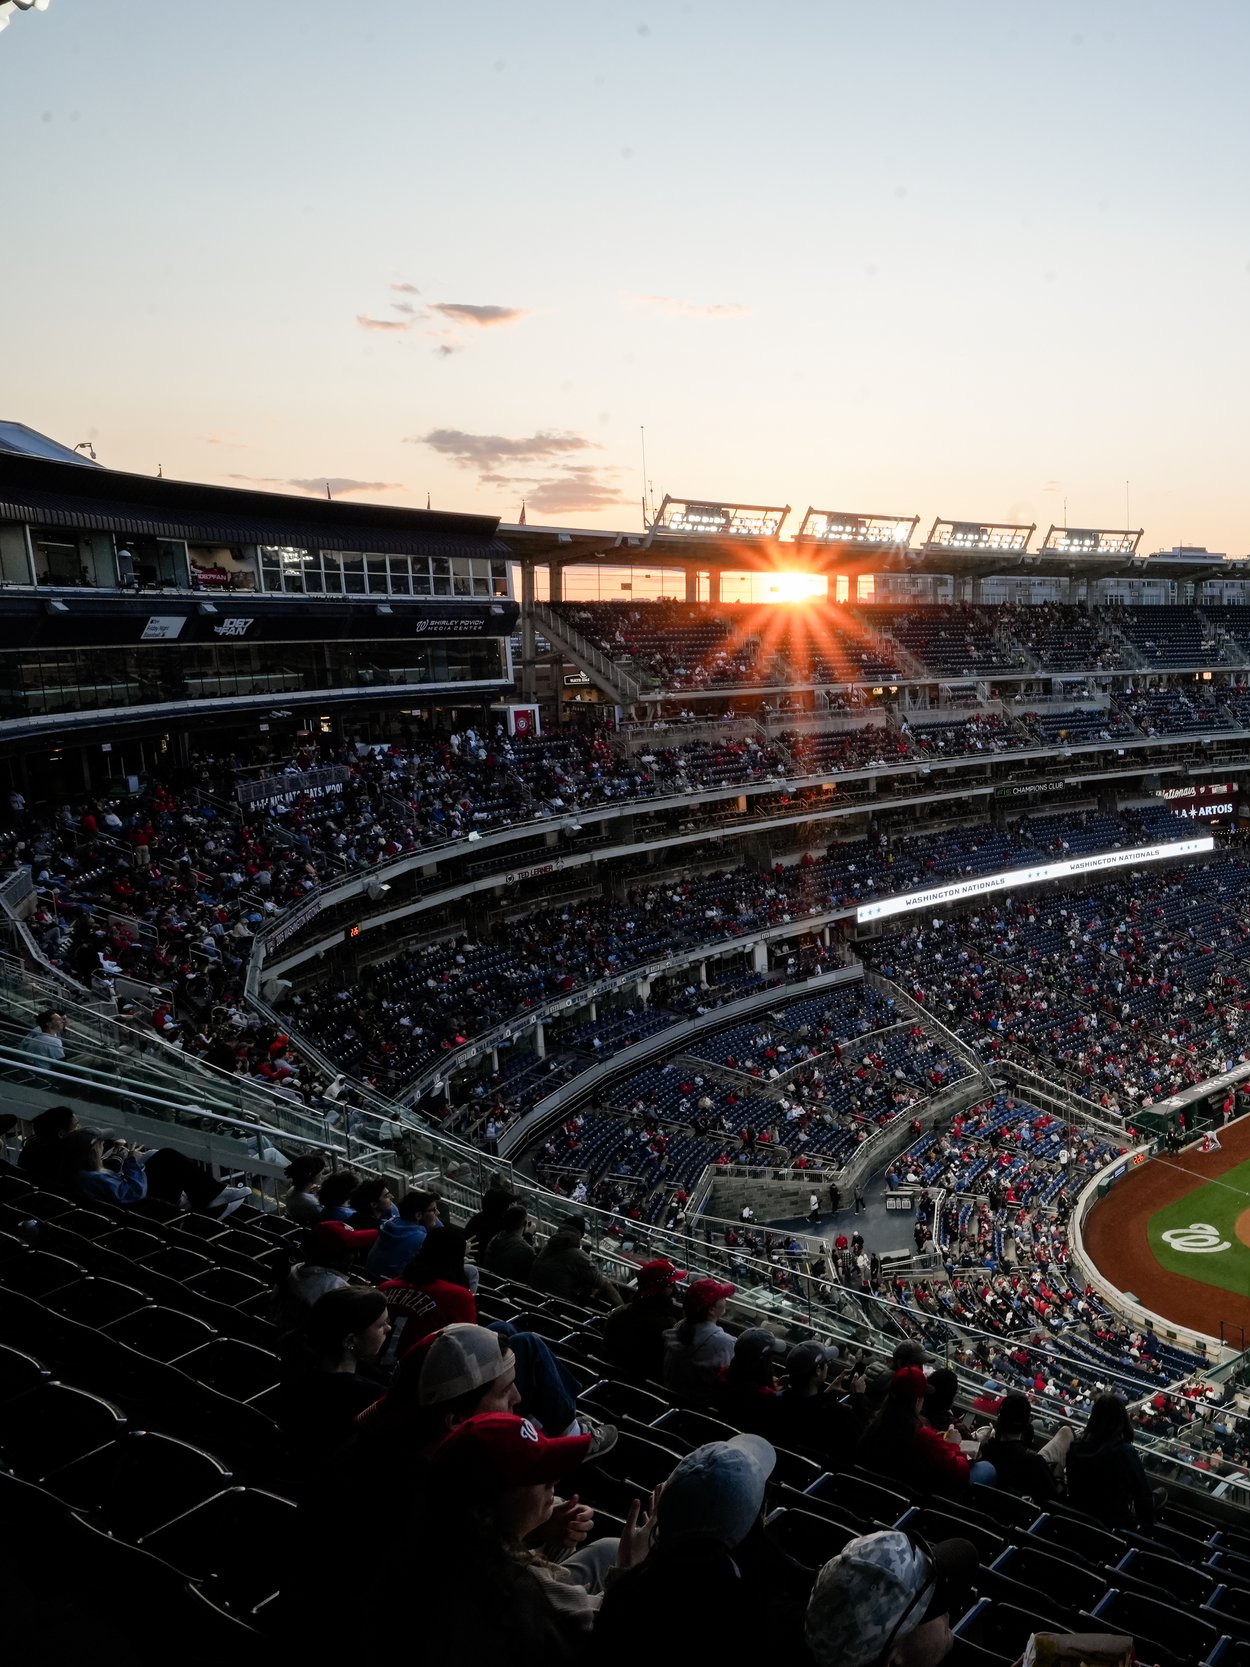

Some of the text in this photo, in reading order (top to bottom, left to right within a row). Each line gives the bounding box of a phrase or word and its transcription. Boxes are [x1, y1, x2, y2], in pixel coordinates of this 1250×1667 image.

[219, 626, 246, 636] FAN
[1013, 784, 1047, 794] CHAMPIONS
[1048, 782, 1064, 790] CLUB
[1198, 803, 1233, 816] ARTOIS
[1070, 850, 1160, 870] WASHINGTON NATIONALS
[517, 864, 553, 880] TED LERNER
[905, 878, 1005, 906] WASHINGTON NATIONALS
[1193, 1079, 1220, 1093] PARK
[386, 1288, 437, 1317] HERZER
